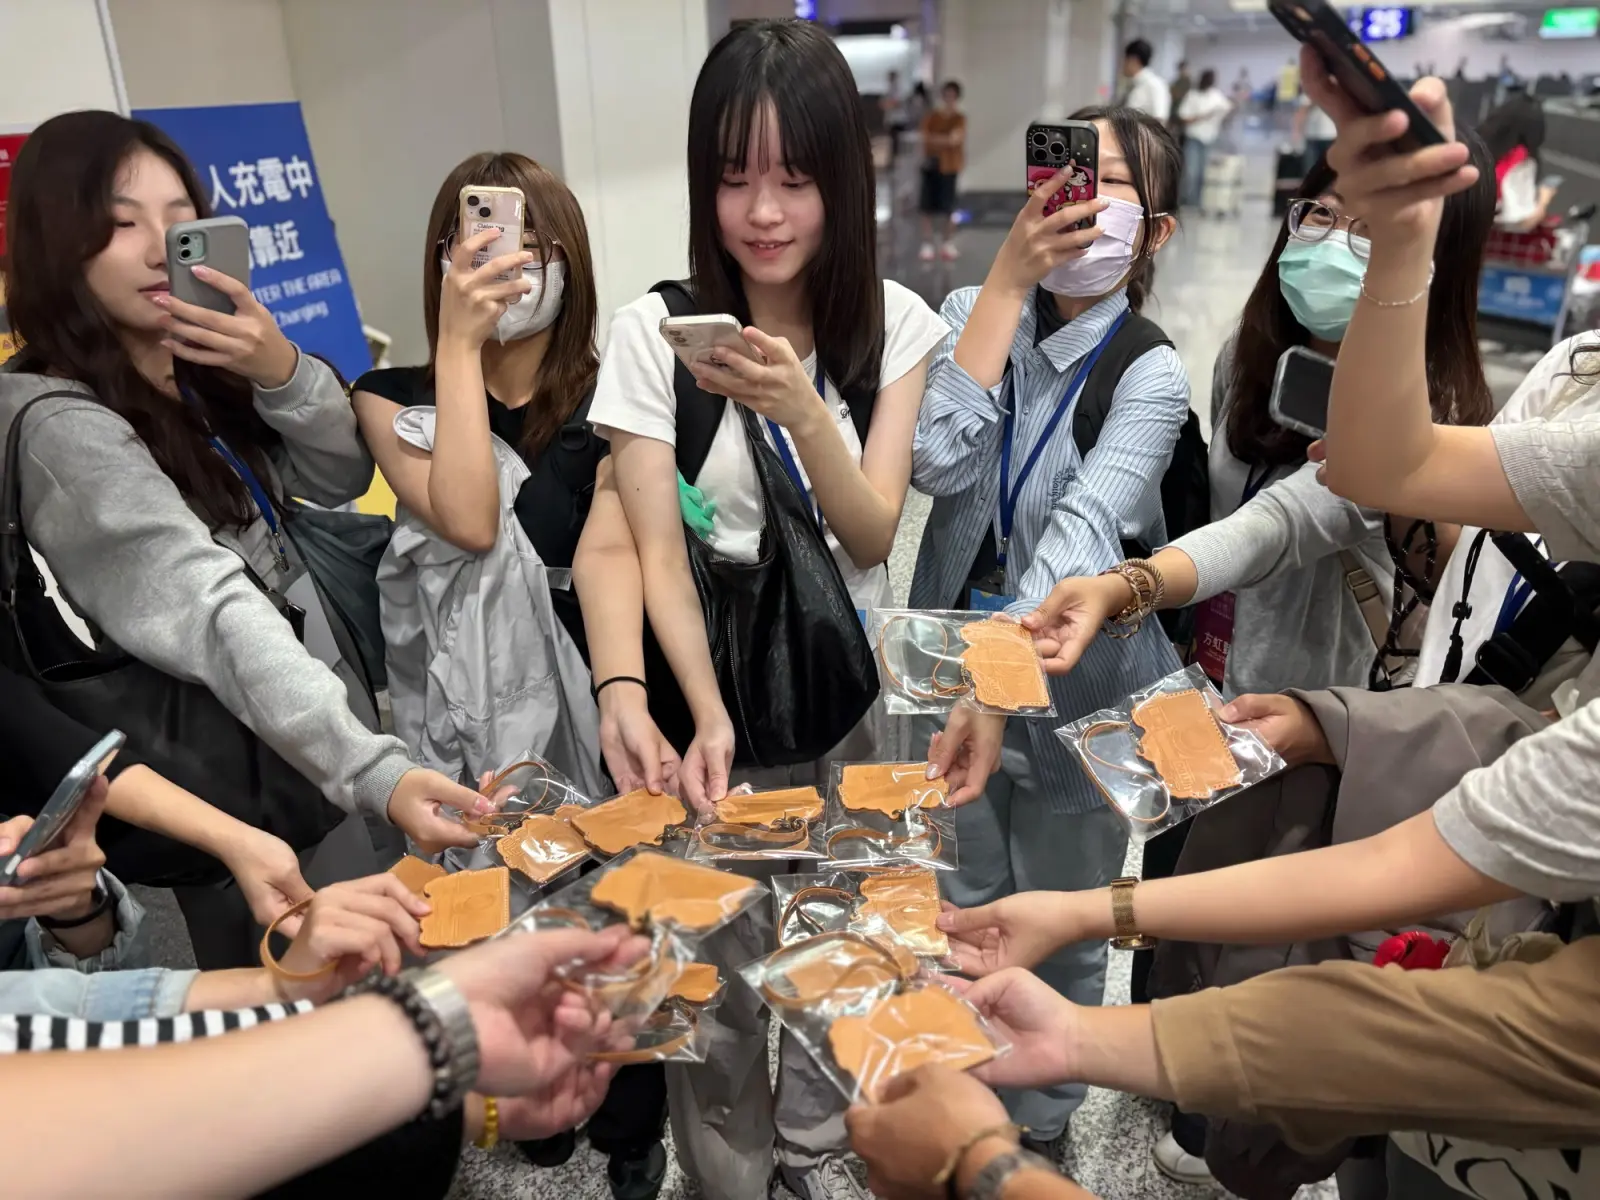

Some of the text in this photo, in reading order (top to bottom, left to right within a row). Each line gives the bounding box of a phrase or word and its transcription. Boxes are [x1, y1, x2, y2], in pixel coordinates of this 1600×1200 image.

[209, 154, 313, 212] 人充電中
[249, 219, 304, 269] 靠近
[252, 283, 282, 305] TER
[281, 276, 309, 298] THE
